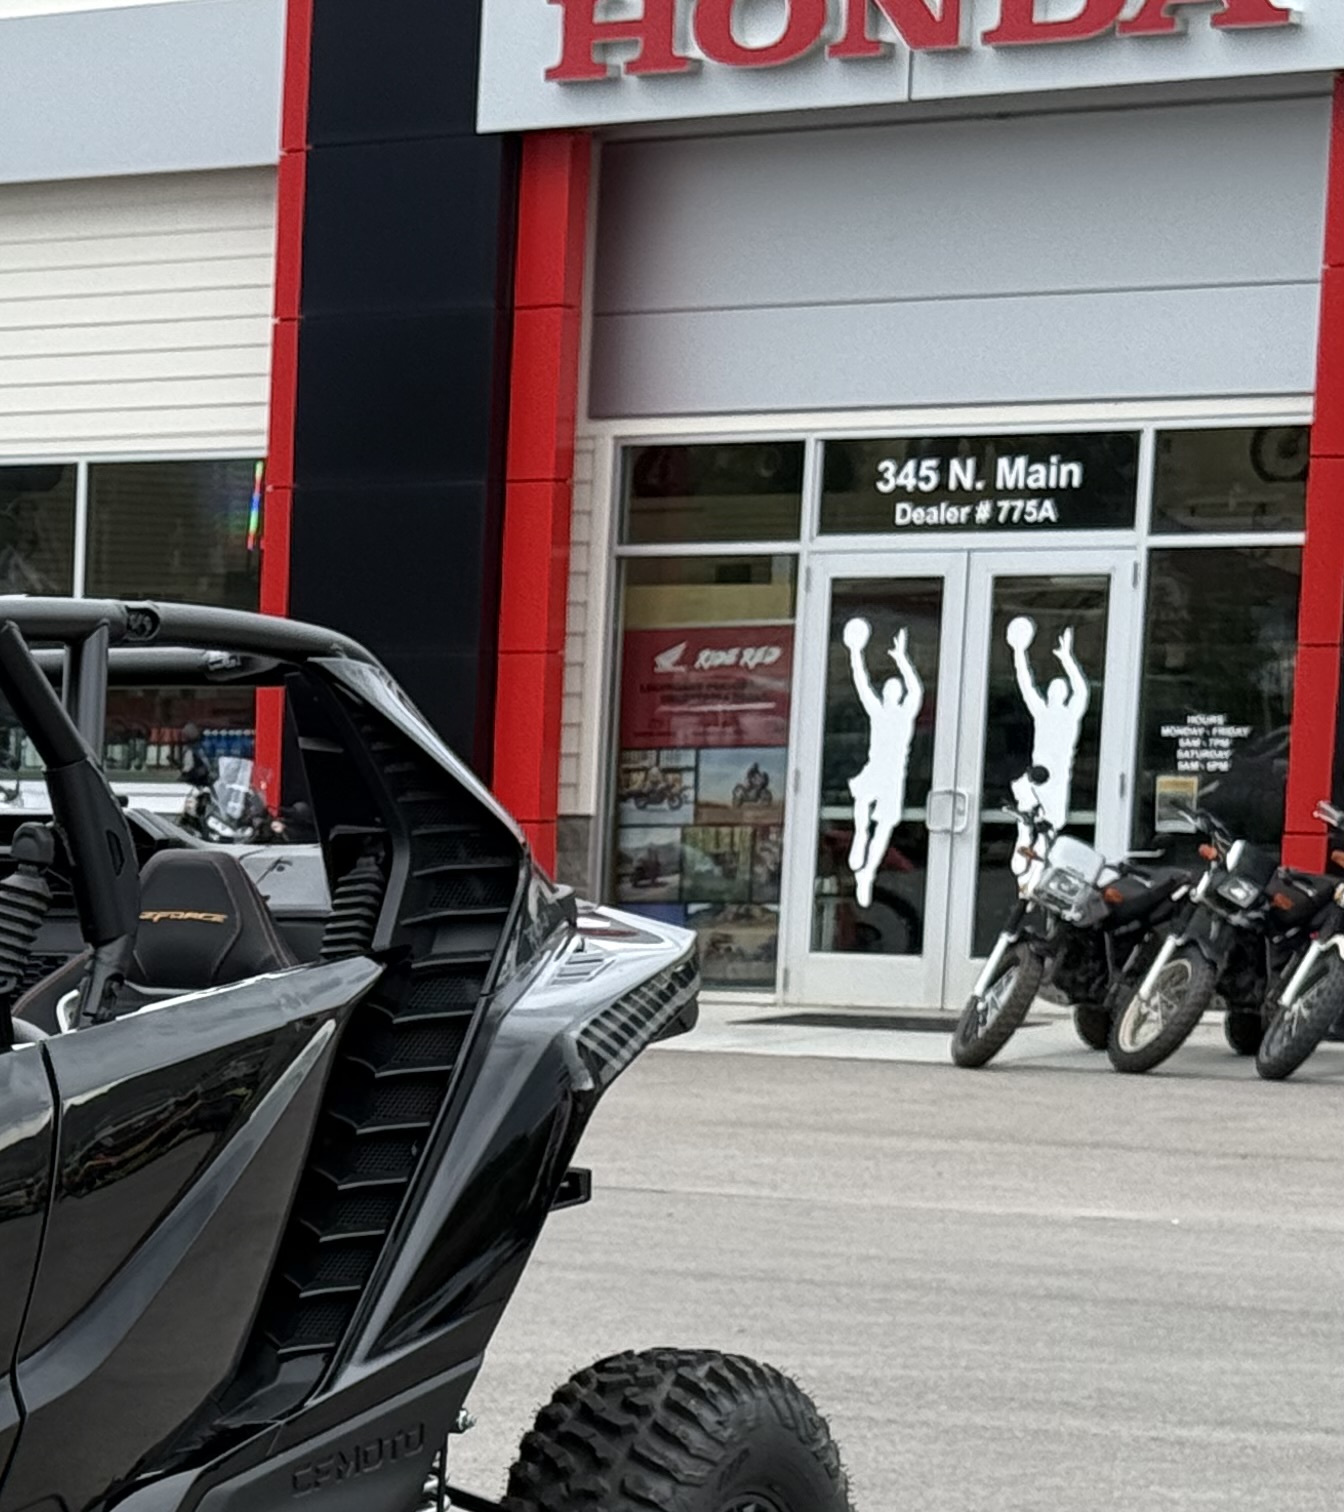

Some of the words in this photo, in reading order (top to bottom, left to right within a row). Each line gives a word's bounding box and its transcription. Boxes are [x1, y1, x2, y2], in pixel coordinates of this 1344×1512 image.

[876, 457, 940, 493] 345
[948, 457, 985, 491] N.
[995, 455, 1083, 490] Main
[894, 502, 971, 526] Dealer
[974, 500, 993, 525] #
[997, 499, 1058, 524] 775A
[1186, 714, 1225, 726] HOURS
[1160, 725, 1205, 737] MONDAY
[1212, 726, 1251, 738] FRIDAY
[1176, 749, 1233, 760] SATURDAY
[291, 1421, 425, 1499] CFMOTO
